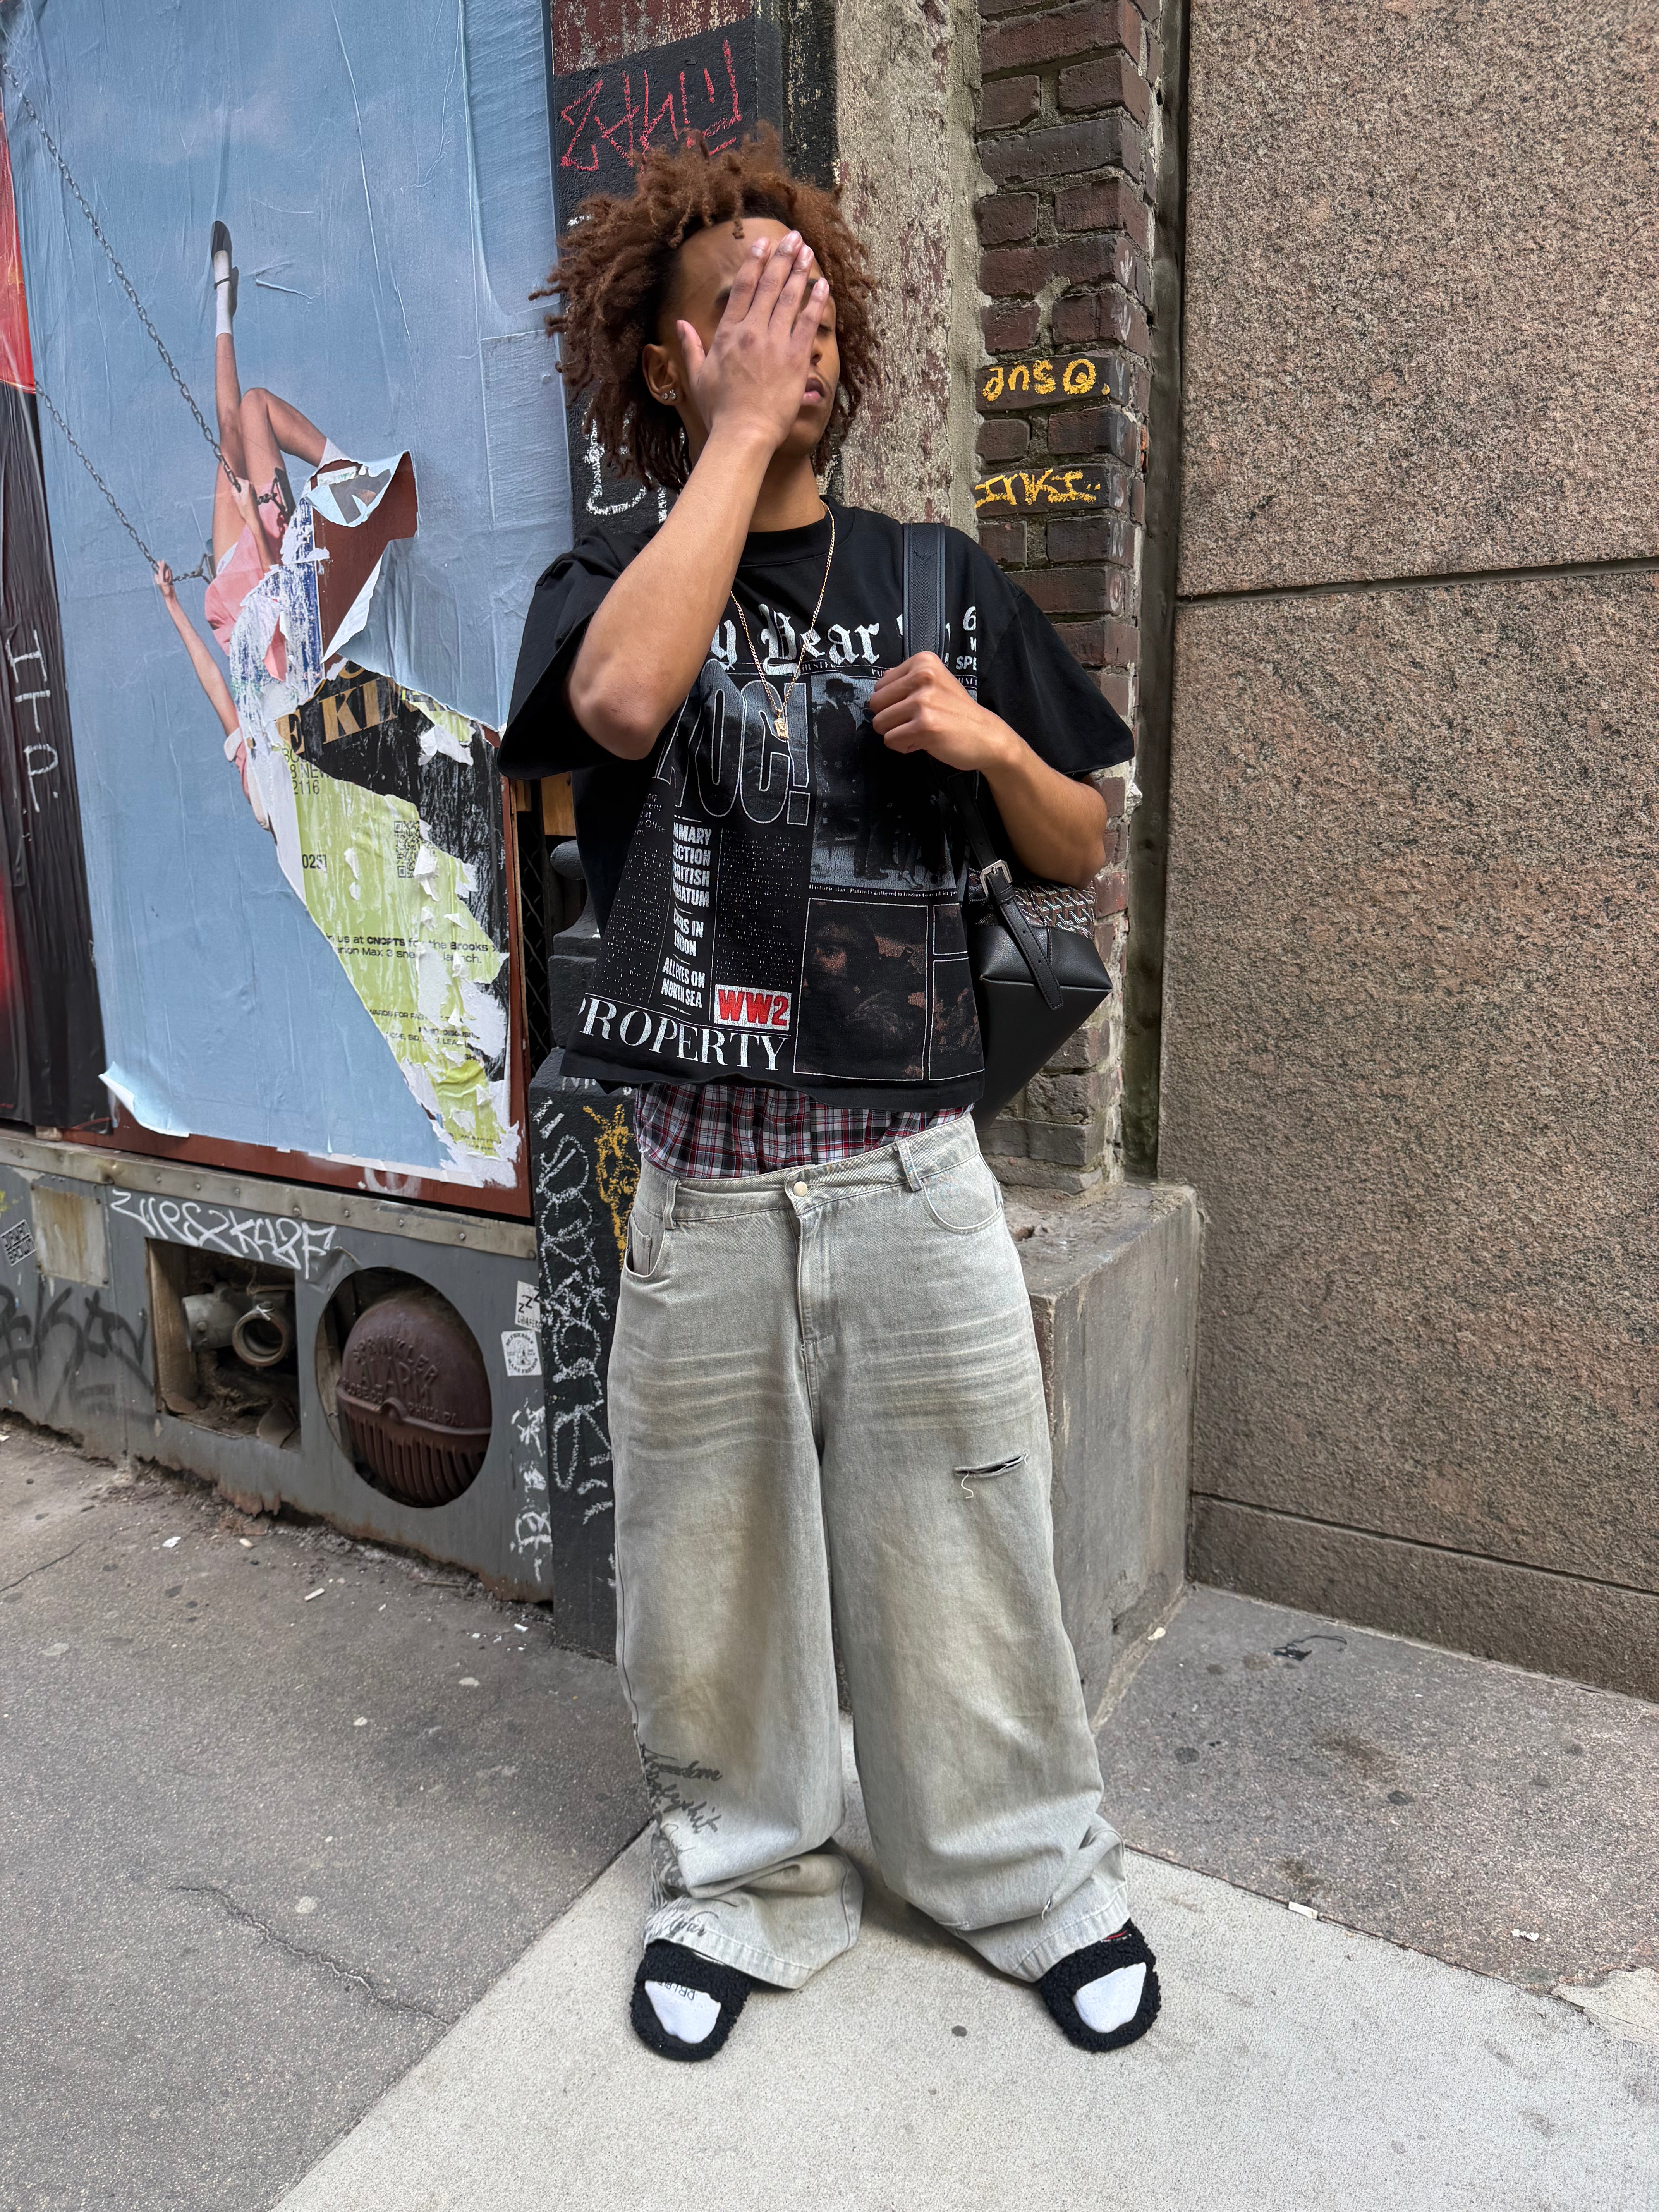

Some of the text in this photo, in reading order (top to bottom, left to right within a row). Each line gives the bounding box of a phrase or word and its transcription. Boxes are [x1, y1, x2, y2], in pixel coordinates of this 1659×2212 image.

[354, 936, 364, 944] at
[362, 948, 383, 957] Max
[691, 970, 705, 989] ON
[685, 988, 702, 1008] SEA
[718, 989, 789, 1026] WW2
